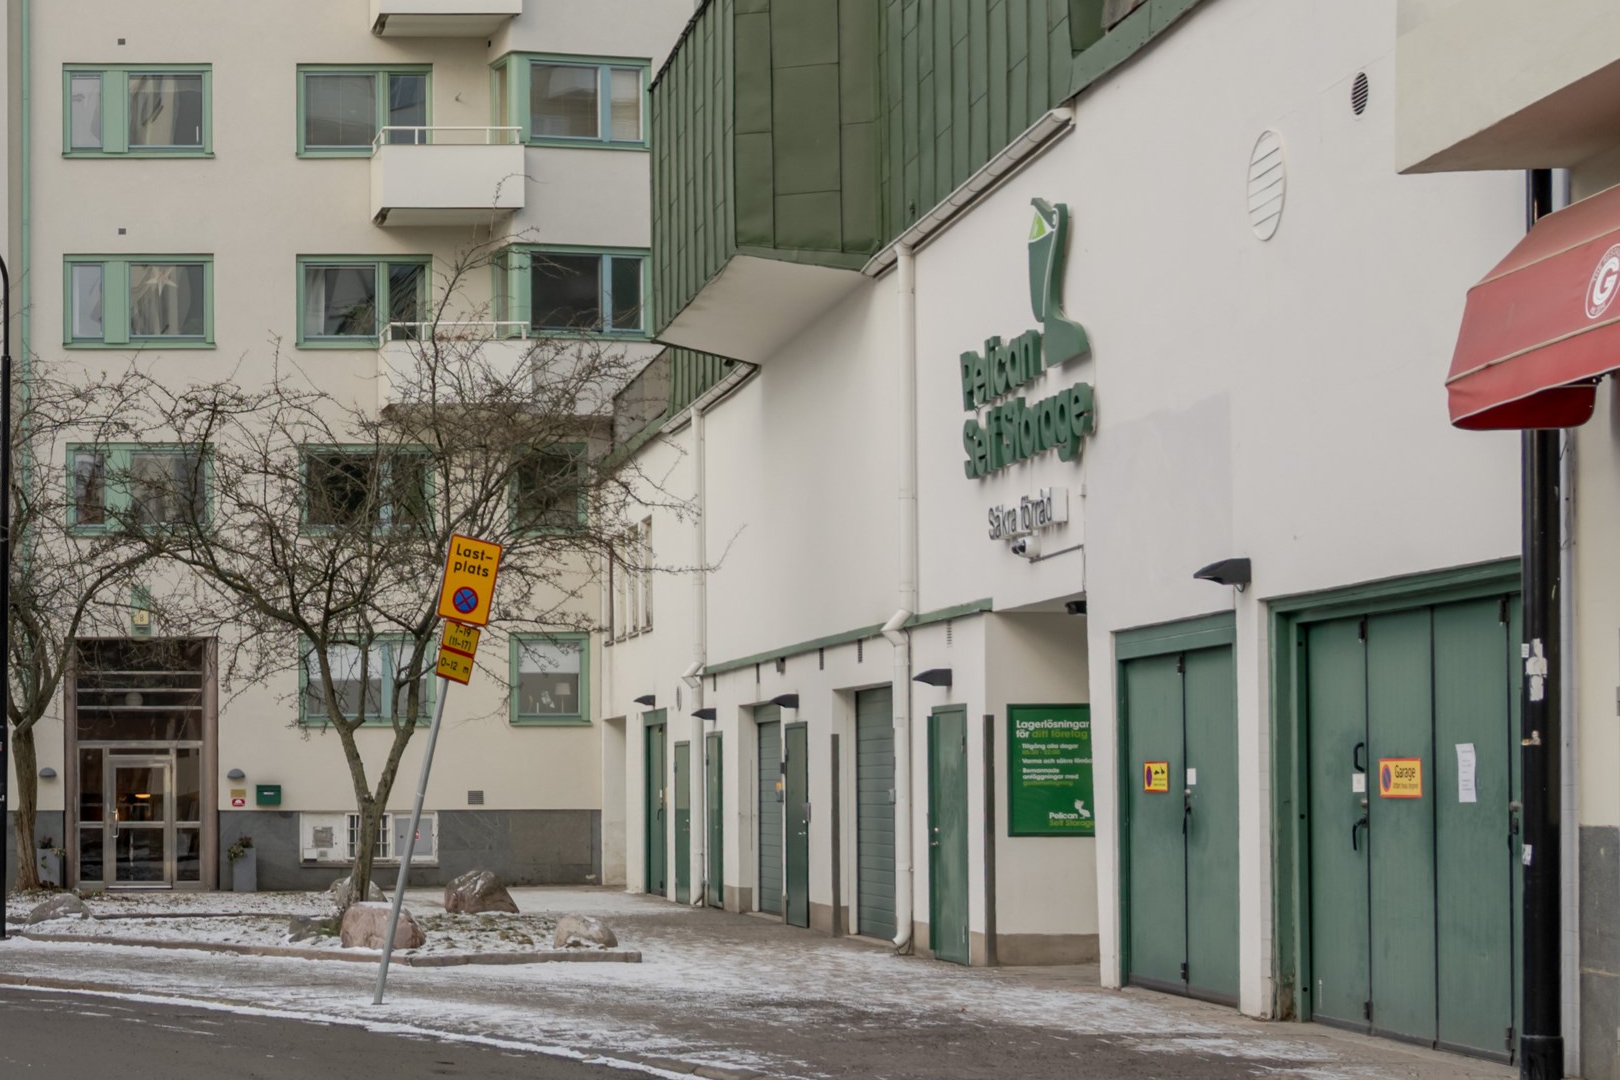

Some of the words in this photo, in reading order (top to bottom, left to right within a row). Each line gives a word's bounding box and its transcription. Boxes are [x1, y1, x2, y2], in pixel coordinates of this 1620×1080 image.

[1593, 256, 1620, 306] G
[960, 329, 1042, 411] Pelican
[988, 504, 1017, 540] Säkra
[1020, 487, 1052, 531] förråd
[456, 543, 493, 561] Last-
[453, 560, 489, 578] plats
[455, 624, 472, 637] 7-19
[448, 635, 472, 651] (11-17)
[440, 657, 458, 671] 0-12
[1016, 719, 1090, 730] Lagerlösningar
[1016, 730, 1030, 738] för
[1032, 730, 1048, 738] ditt
[1051, 730, 1088, 739] företag
[1395, 764, 1416, 781] Garage
[1049, 811, 1078, 819] Pelican
